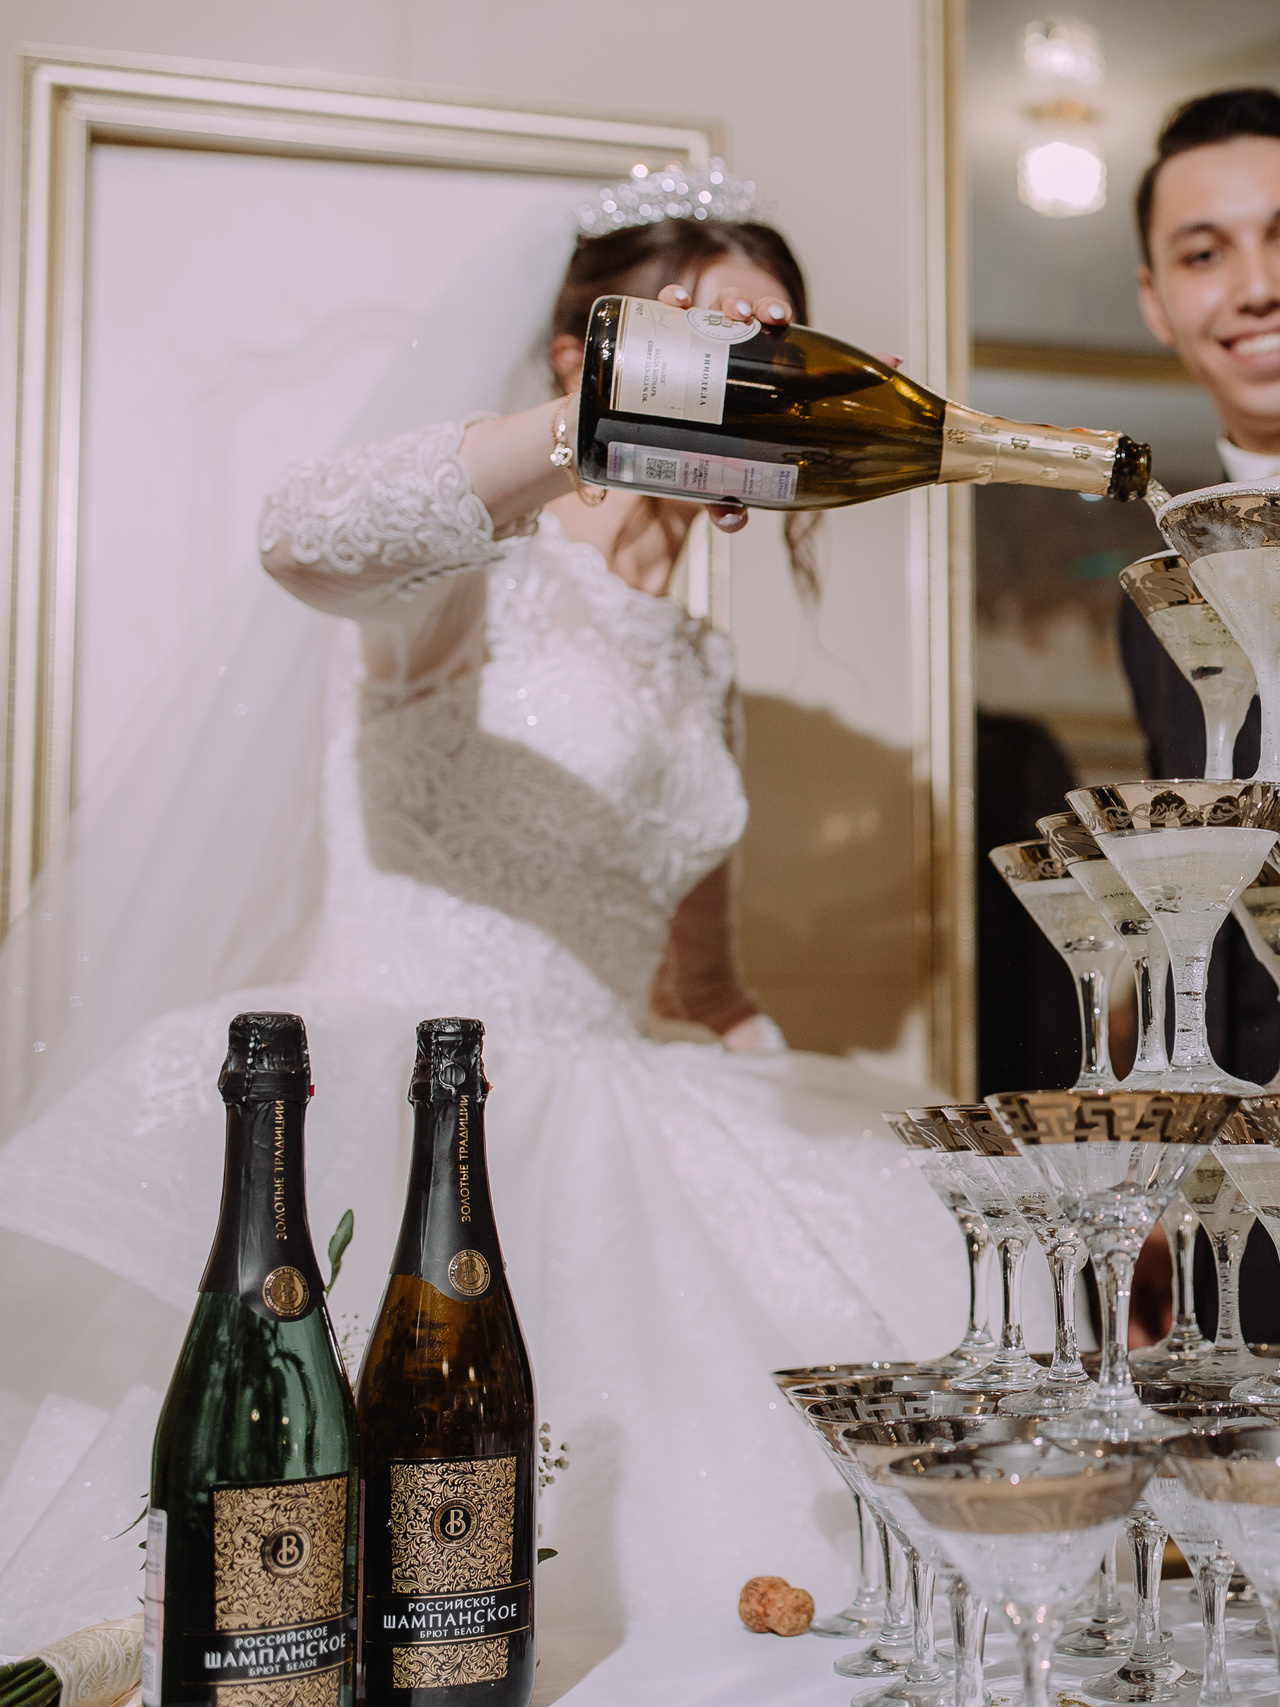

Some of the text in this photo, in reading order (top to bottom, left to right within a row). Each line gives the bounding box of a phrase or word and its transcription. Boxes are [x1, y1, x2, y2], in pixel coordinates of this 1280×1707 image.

[274, 1100, 288, 1240] ЗОЛОТЫЕ ТРАДИЦИИ
[458, 1094, 471, 1223] ЗОЛОТЫЕ ТРАДИЦИИ
[408, 1595, 496, 1612] РОССИЙСКОЕ
[383, 1603, 517, 1629] ШАМПАНСКОЕ
[234, 1626, 328, 1649] РОССИЙСКОЕ
[420, 1625, 485, 1638] БРЮТ БЕЛОЕ
[204, 1633, 346, 1669] ШАМПАНСКОЕ
[248, 1658, 318, 1677] БРЮТ БЕЛОЕ
